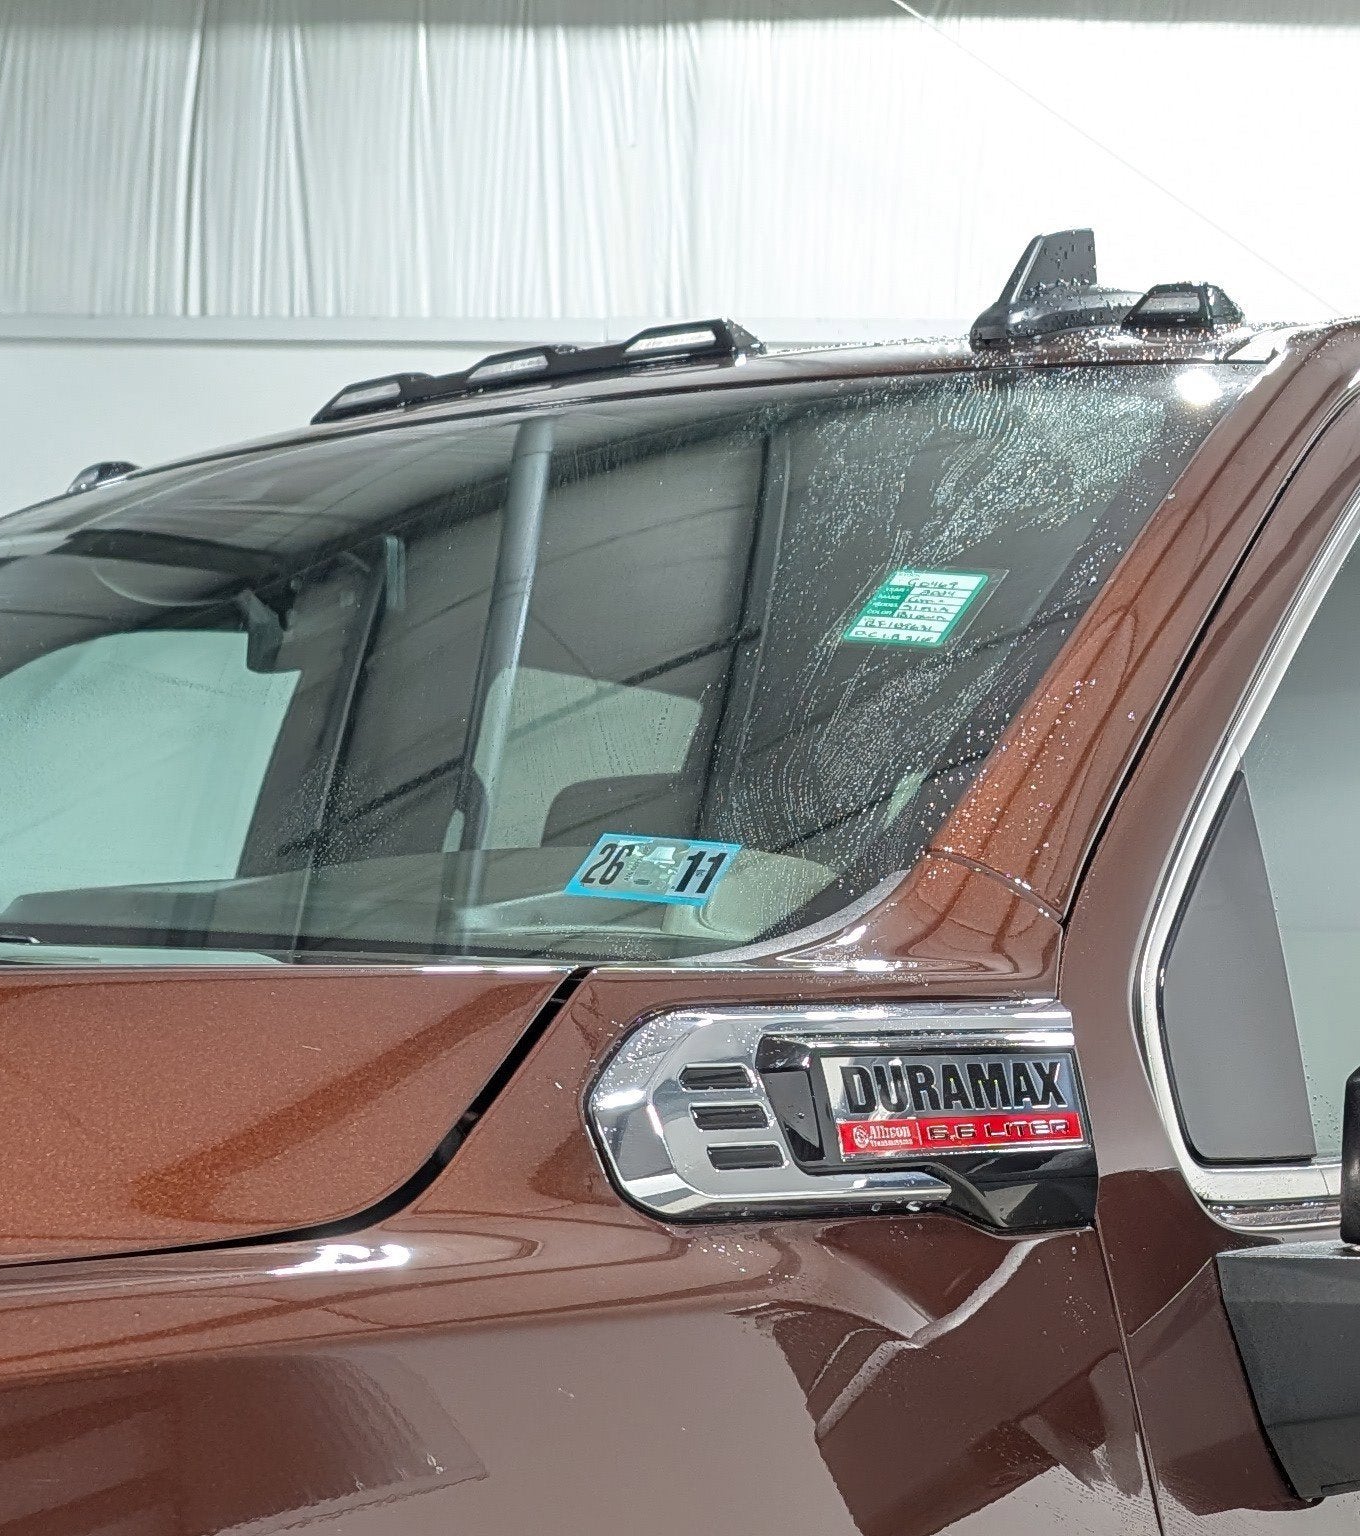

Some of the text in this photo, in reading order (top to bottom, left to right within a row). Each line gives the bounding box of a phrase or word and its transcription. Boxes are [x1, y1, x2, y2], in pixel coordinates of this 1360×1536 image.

[580, 843, 636, 885] 26
[674, 851, 728, 894] 11
[839, 1061, 1069, 1115] DURAMAX
[869, 1125, 912, 1139] Allison
[926, 1119, 1070, 1142] 6.6 LITER
